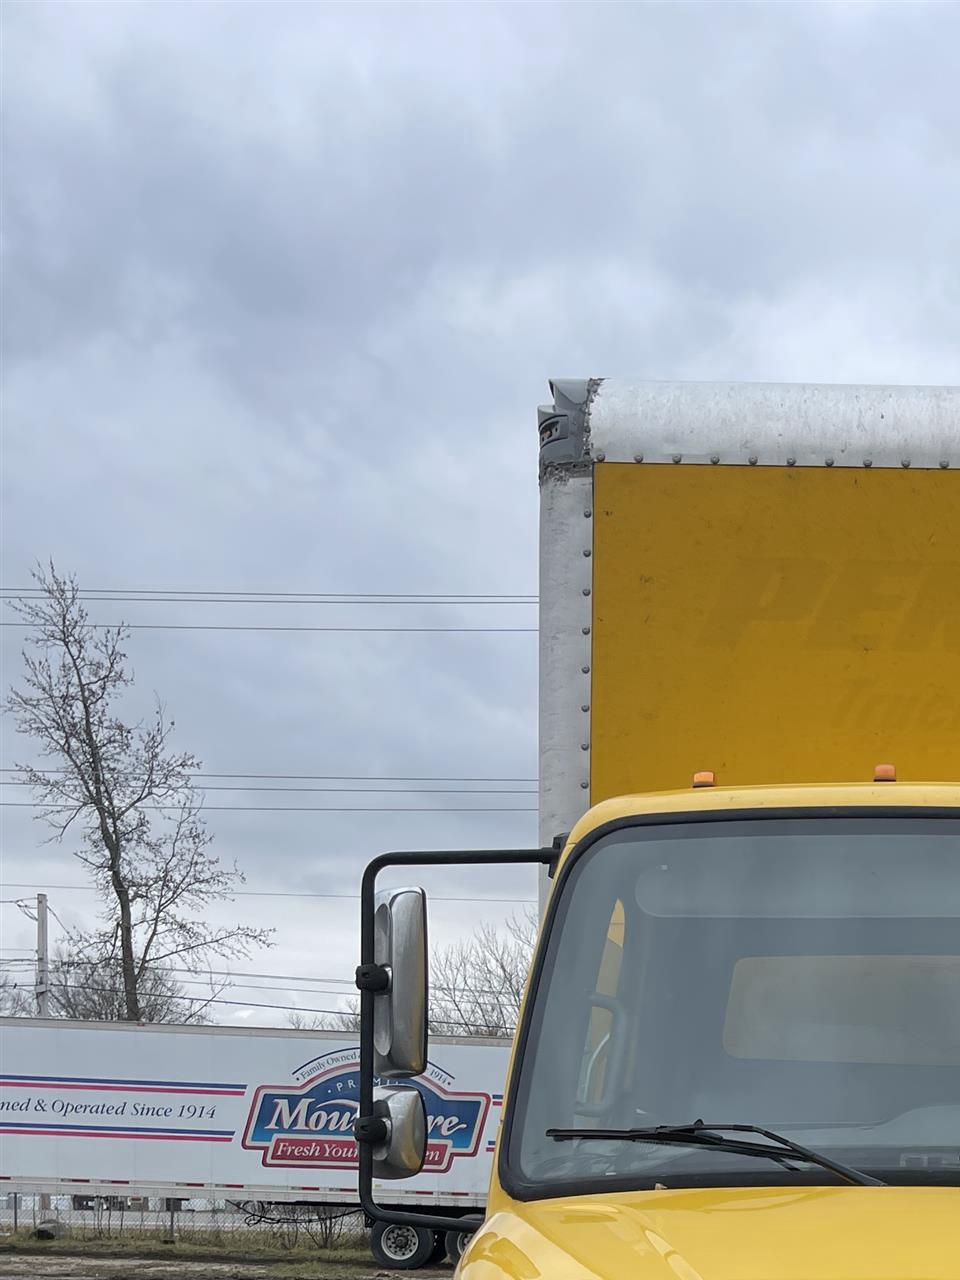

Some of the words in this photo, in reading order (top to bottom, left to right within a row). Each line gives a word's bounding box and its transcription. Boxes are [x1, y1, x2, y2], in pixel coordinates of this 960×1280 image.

[301, 1061, 325, 1079] Family
[326, 1051, 357, 1065] Owned
[0, 1097, 31, 1112] ned
[34, 1098, 48, 1112] &
[51, 1099, 127, 1117] Operated
[131, 1102, 173, 1118] Since
[177, 1104, 217, 1120] 1914
[264, 1098, 467, 1136] Moure
[276, 1142, 320, 1157] Fresh
